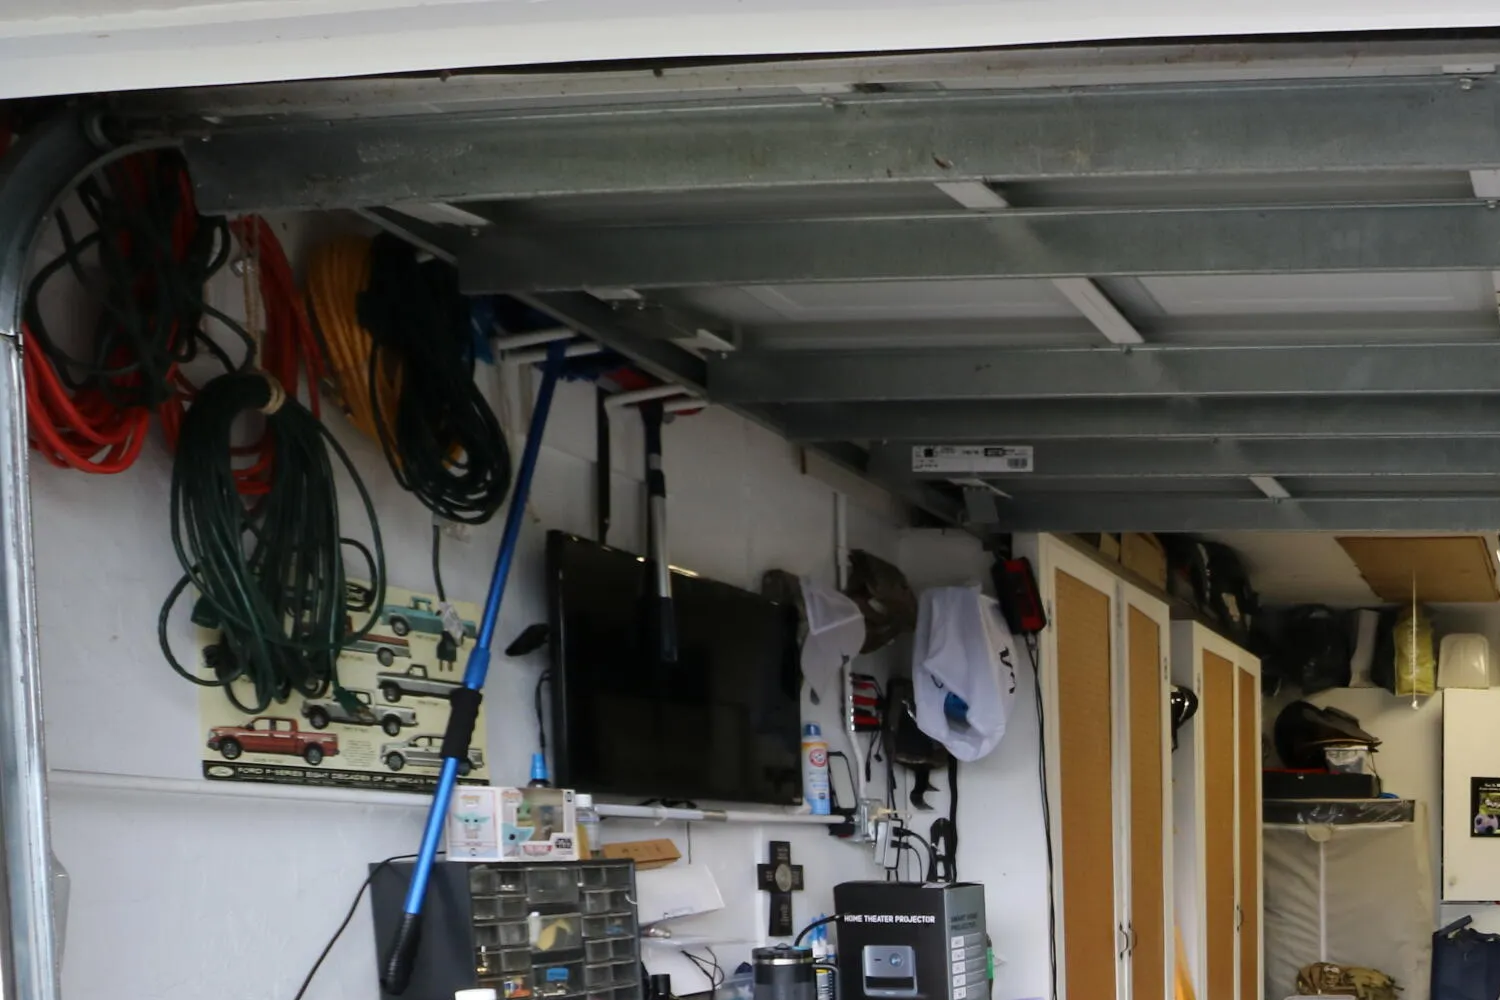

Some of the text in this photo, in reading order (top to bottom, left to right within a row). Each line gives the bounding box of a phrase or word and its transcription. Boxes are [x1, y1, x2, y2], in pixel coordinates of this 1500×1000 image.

[238, 767, 263, 775] FORD
[843, 914, 936, 924] HOME THEATER PROJECTOR
